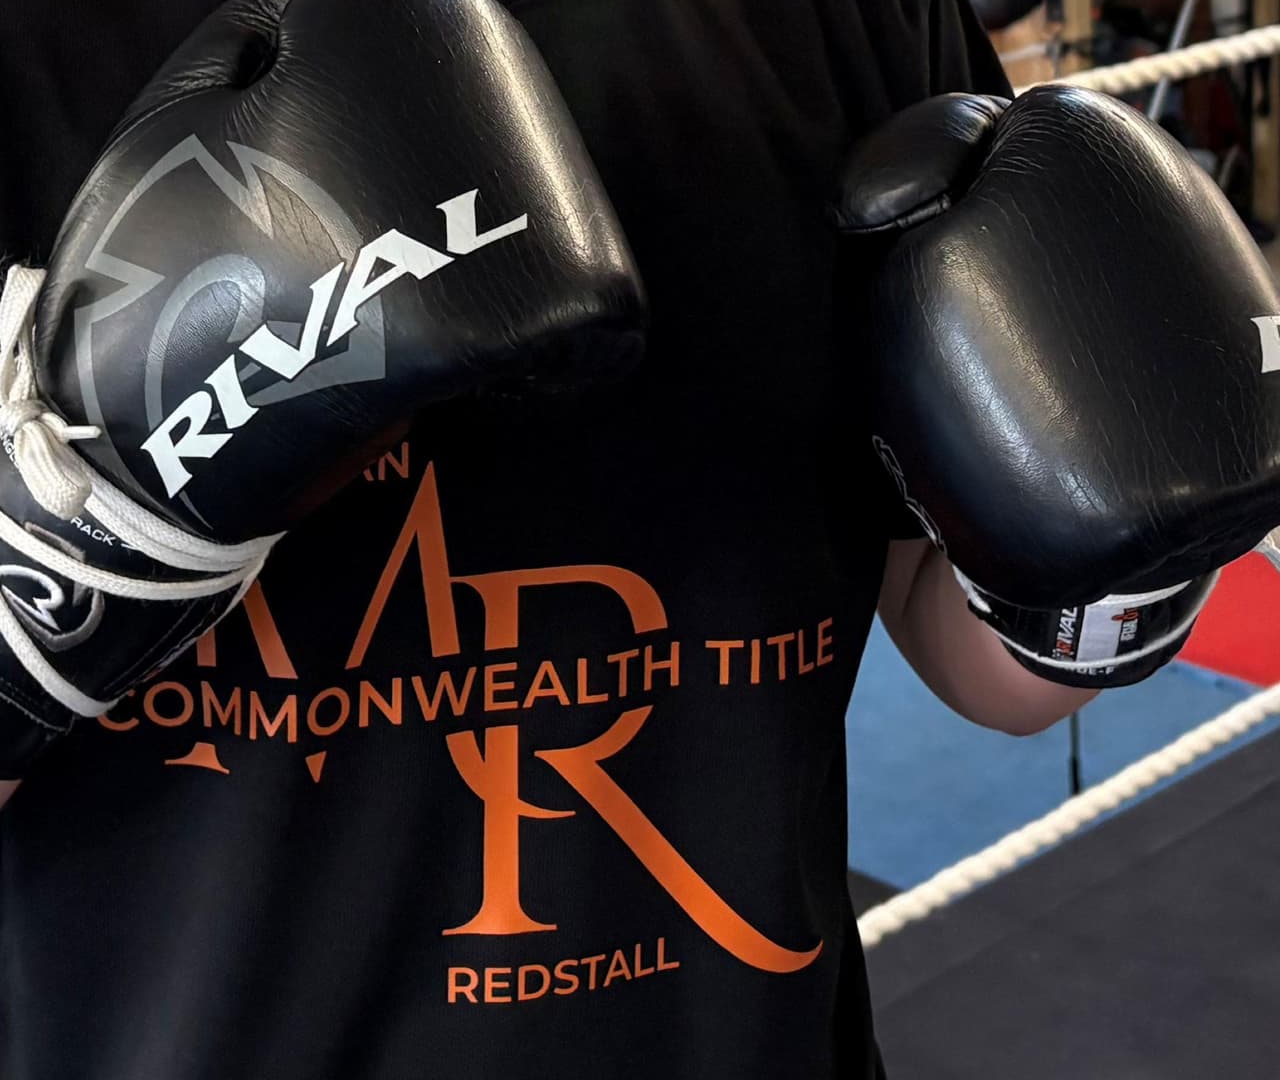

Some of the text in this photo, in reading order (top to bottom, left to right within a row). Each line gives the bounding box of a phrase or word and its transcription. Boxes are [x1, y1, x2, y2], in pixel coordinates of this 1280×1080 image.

[140, 188, 528, 499] RIVAL
[70, 516, 116, 546] RACK
[705, 616, 834, 685] TITLE
[447, 936, 680, 1004] REDSTALL
